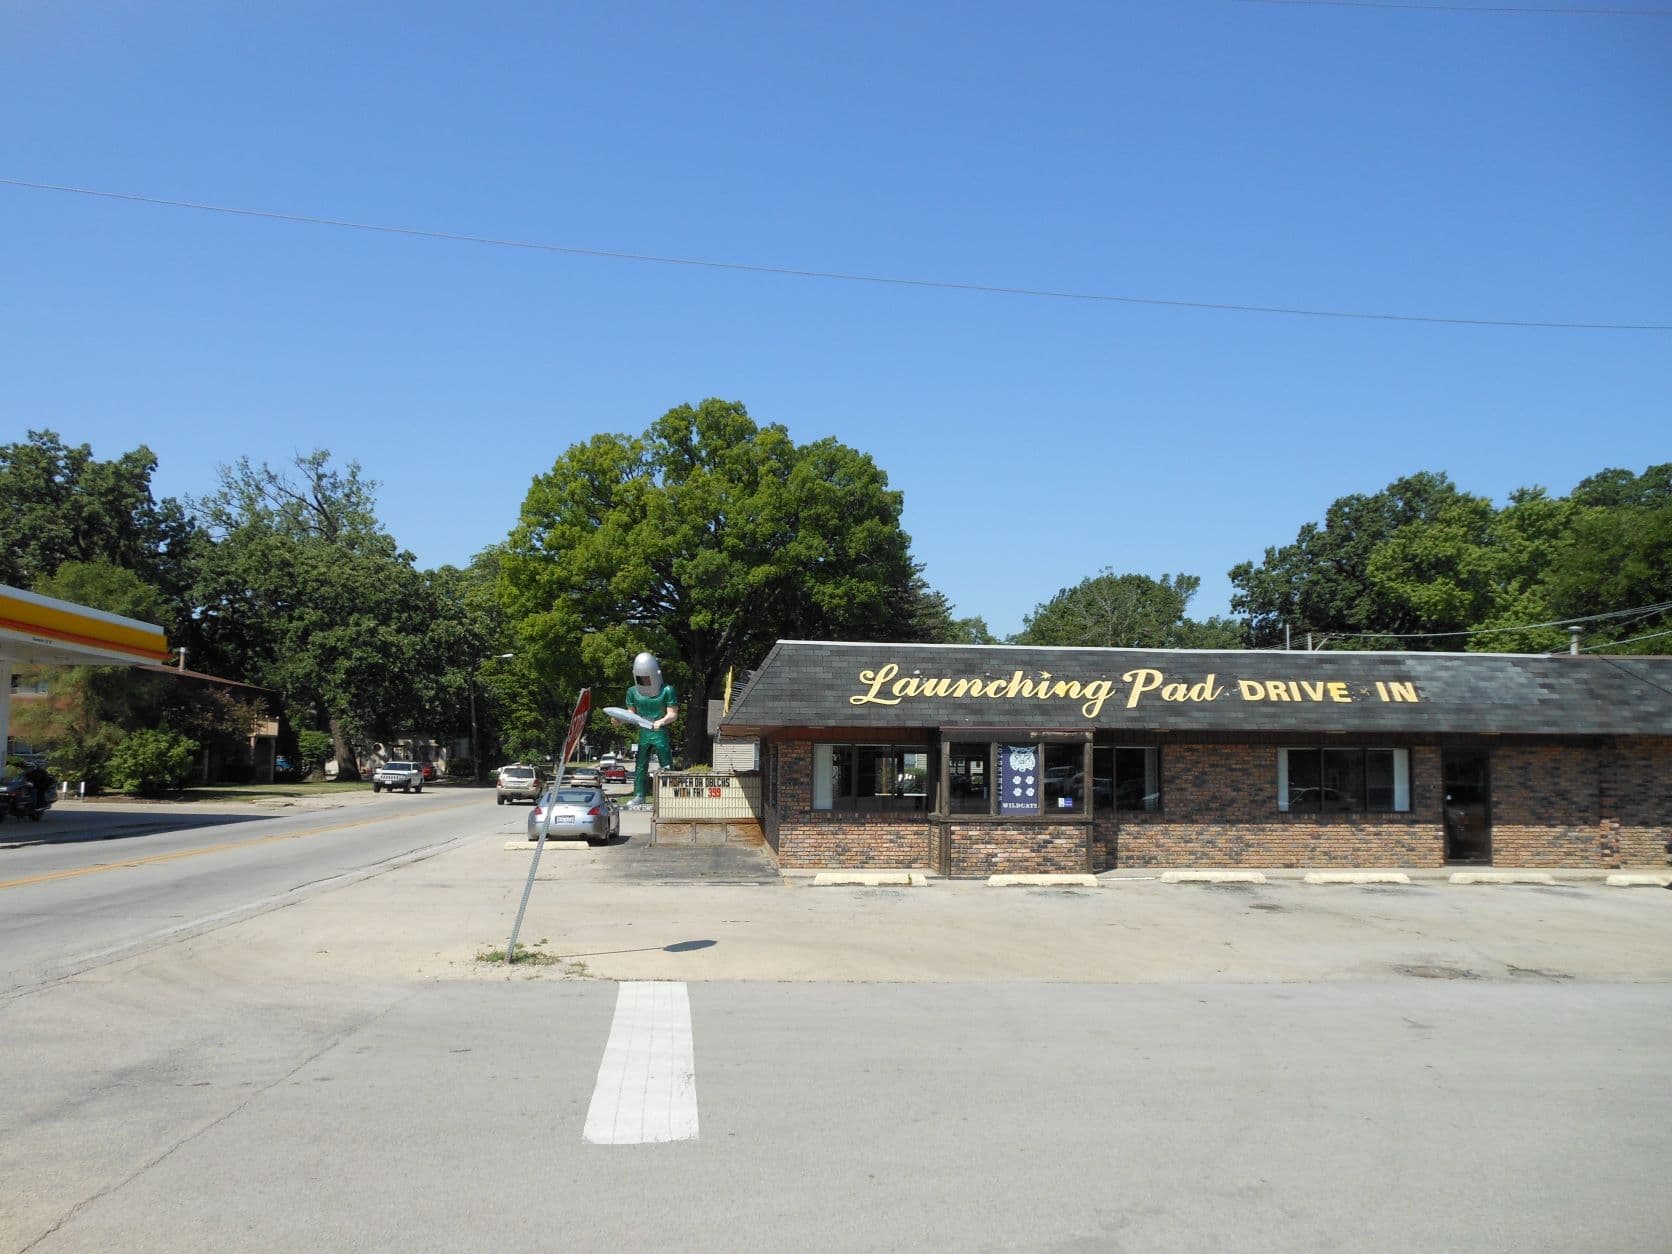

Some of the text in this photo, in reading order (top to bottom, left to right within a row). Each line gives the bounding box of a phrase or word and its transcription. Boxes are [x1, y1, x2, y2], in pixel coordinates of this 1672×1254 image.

[849, 662, 1420, 719] Launching Pad DRIVE IN
[708, 787, 721, 797] 399
